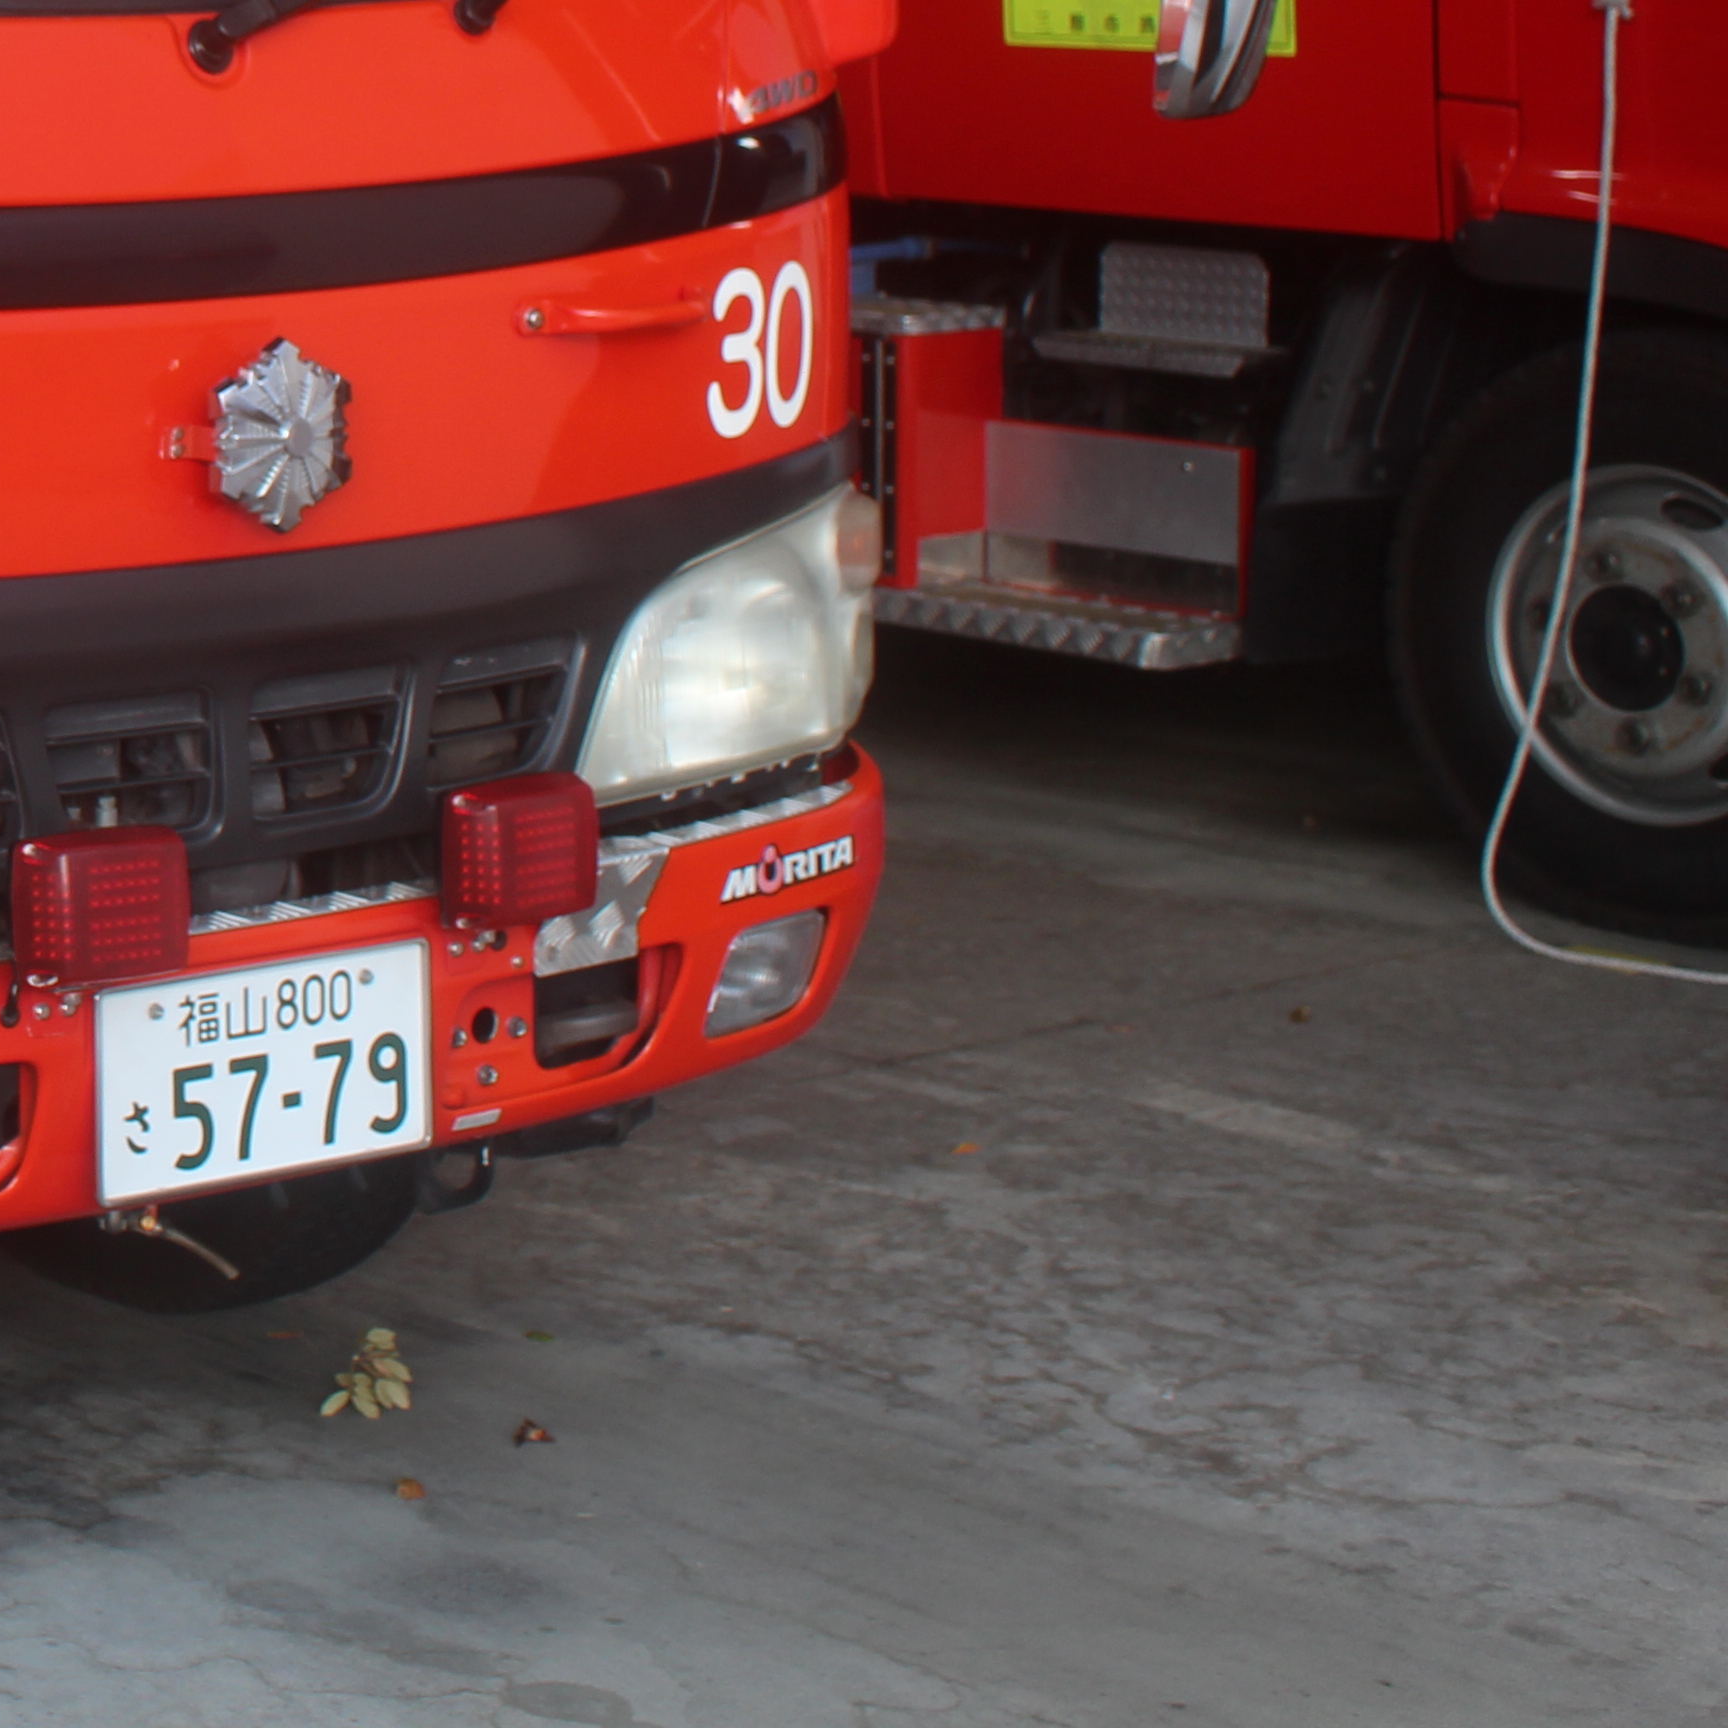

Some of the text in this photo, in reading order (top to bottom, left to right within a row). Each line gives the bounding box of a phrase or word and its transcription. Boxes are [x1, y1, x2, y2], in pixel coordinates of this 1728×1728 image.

[706, 260, 813, 439] 30
[720, 834, 854, 904] MORITA
[123, 1031, 409, 1171] さ 57-79
